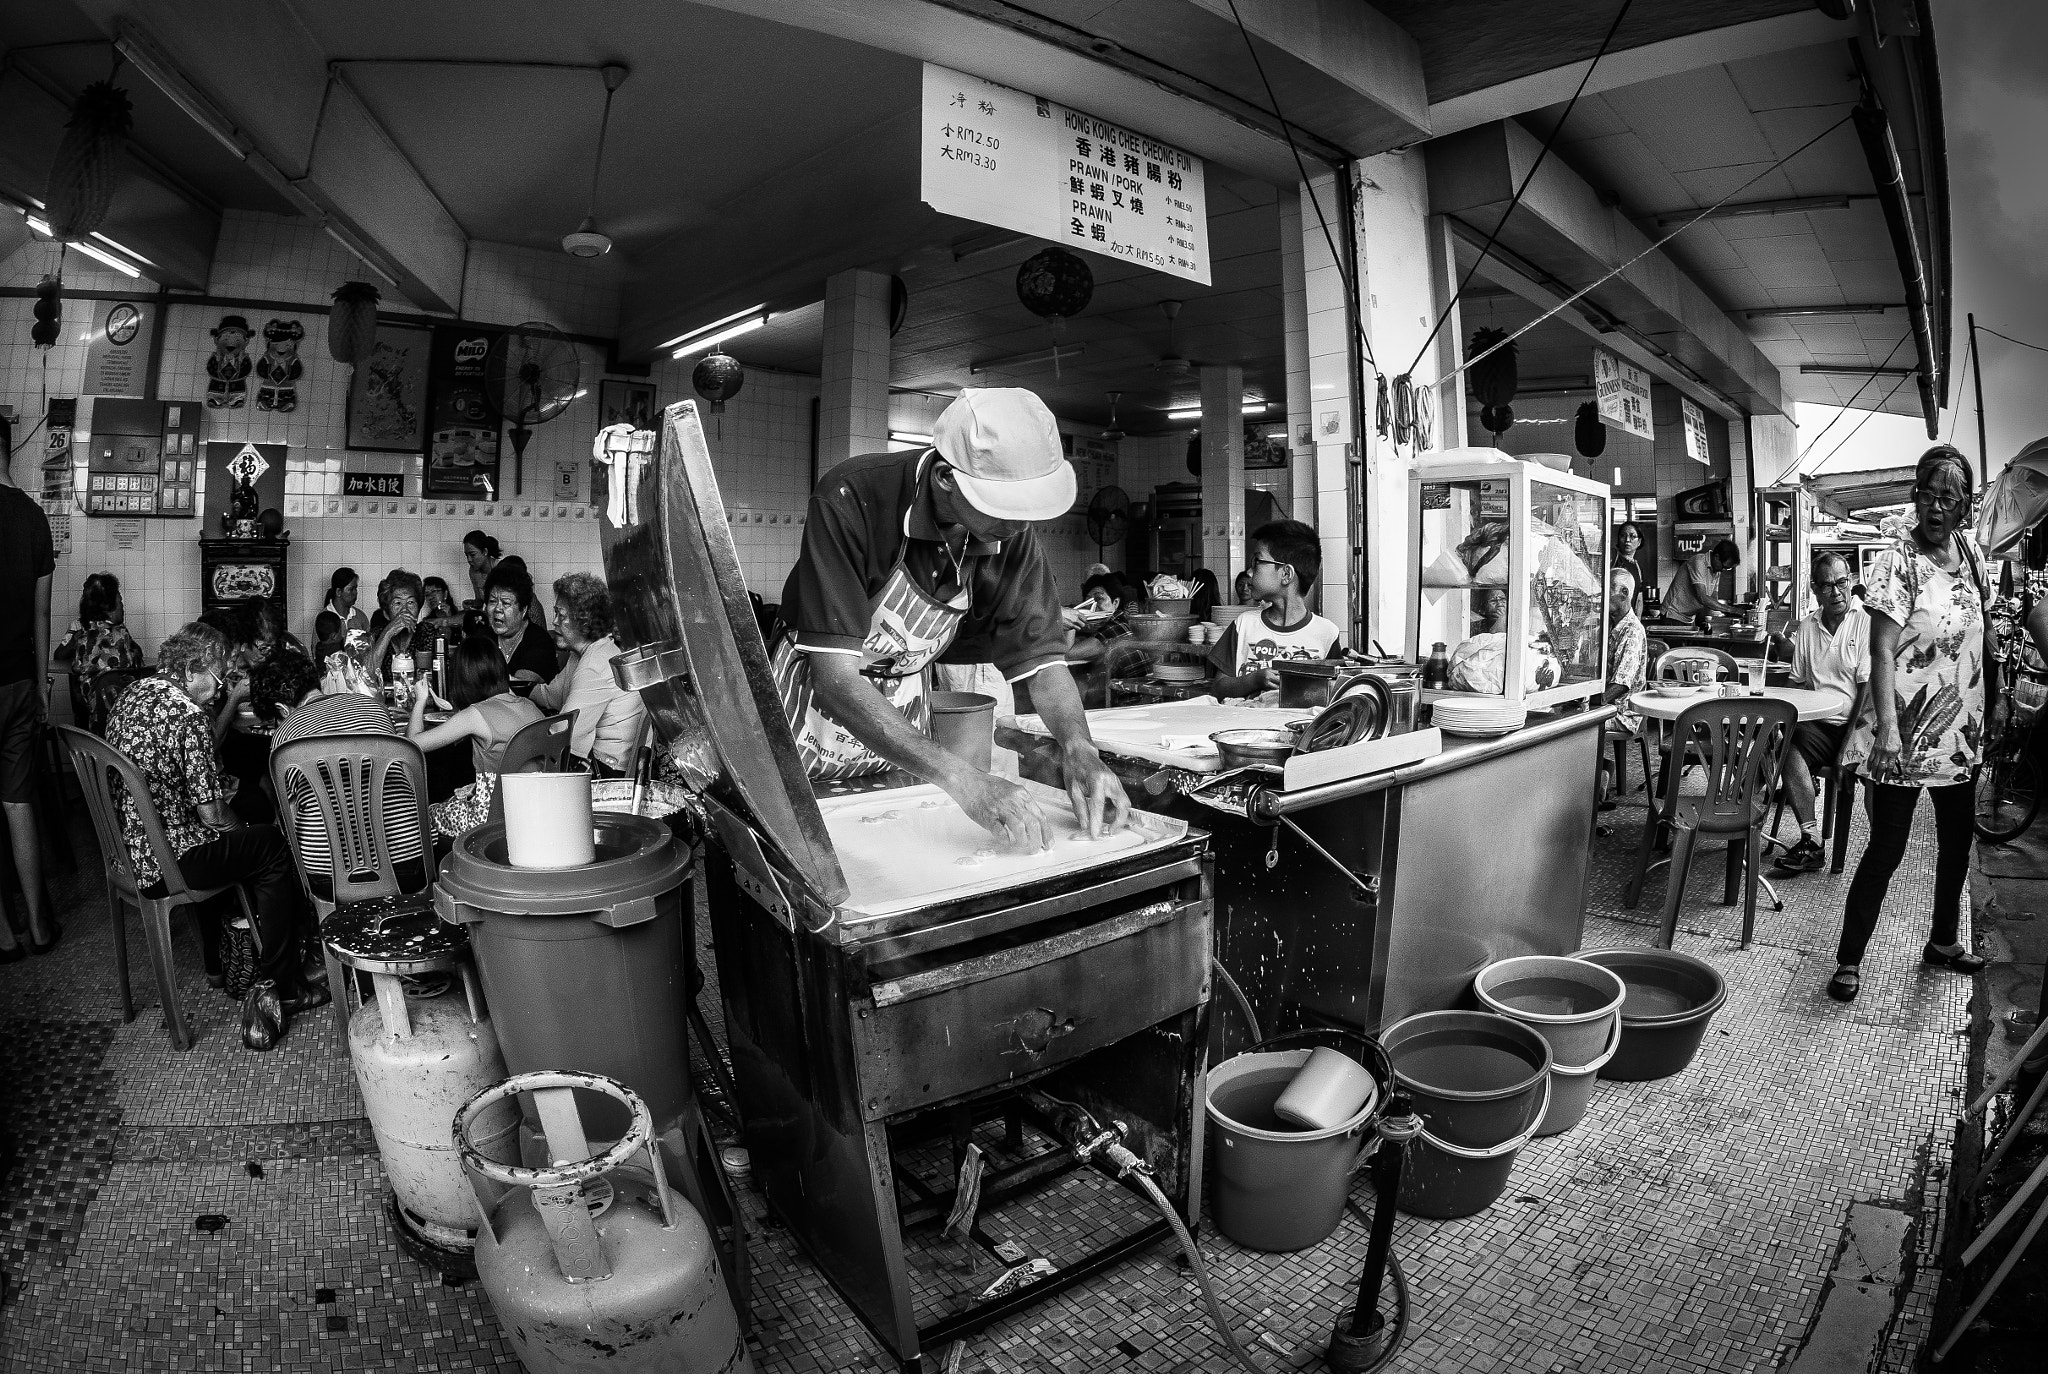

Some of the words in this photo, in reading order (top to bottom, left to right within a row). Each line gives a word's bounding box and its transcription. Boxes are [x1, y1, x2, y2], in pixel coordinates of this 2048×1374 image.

[957, 126, 999, 150] RM2.50
[1064, 111, 1090, 135] HONG
[1092, 121, 1117, 145] KONG
[1118, 131, 1141, 154] CHEE
[1142, 140, 1174, 166] CHEONG
[1176, 152, 1192, 173] FUN
[956, 148, 997, 171] RM3.30
[1069, 158, 1109, 184] PRAWN
[1075, 136, 1183, 190] 香港豬腸粉
[1069, 175, 1145, 215] 鮮蝦叉燒
[1072, 199, 1112, 224] PRAWN
[1070, 216, 1106, 243] 全蝦
[457, 345, 486, 357] MILO
[1597, 380, 1621, 399] GUINNESS
[49, 432, 65, 449] 26
[239, 454, 256, 474] 福
[348, 476, 401, 494] 加水自便
[563, 474, 570, 484] B
[1254, 646, 1276, 657] POLI
[803, 731, 835, 759] Jenama
